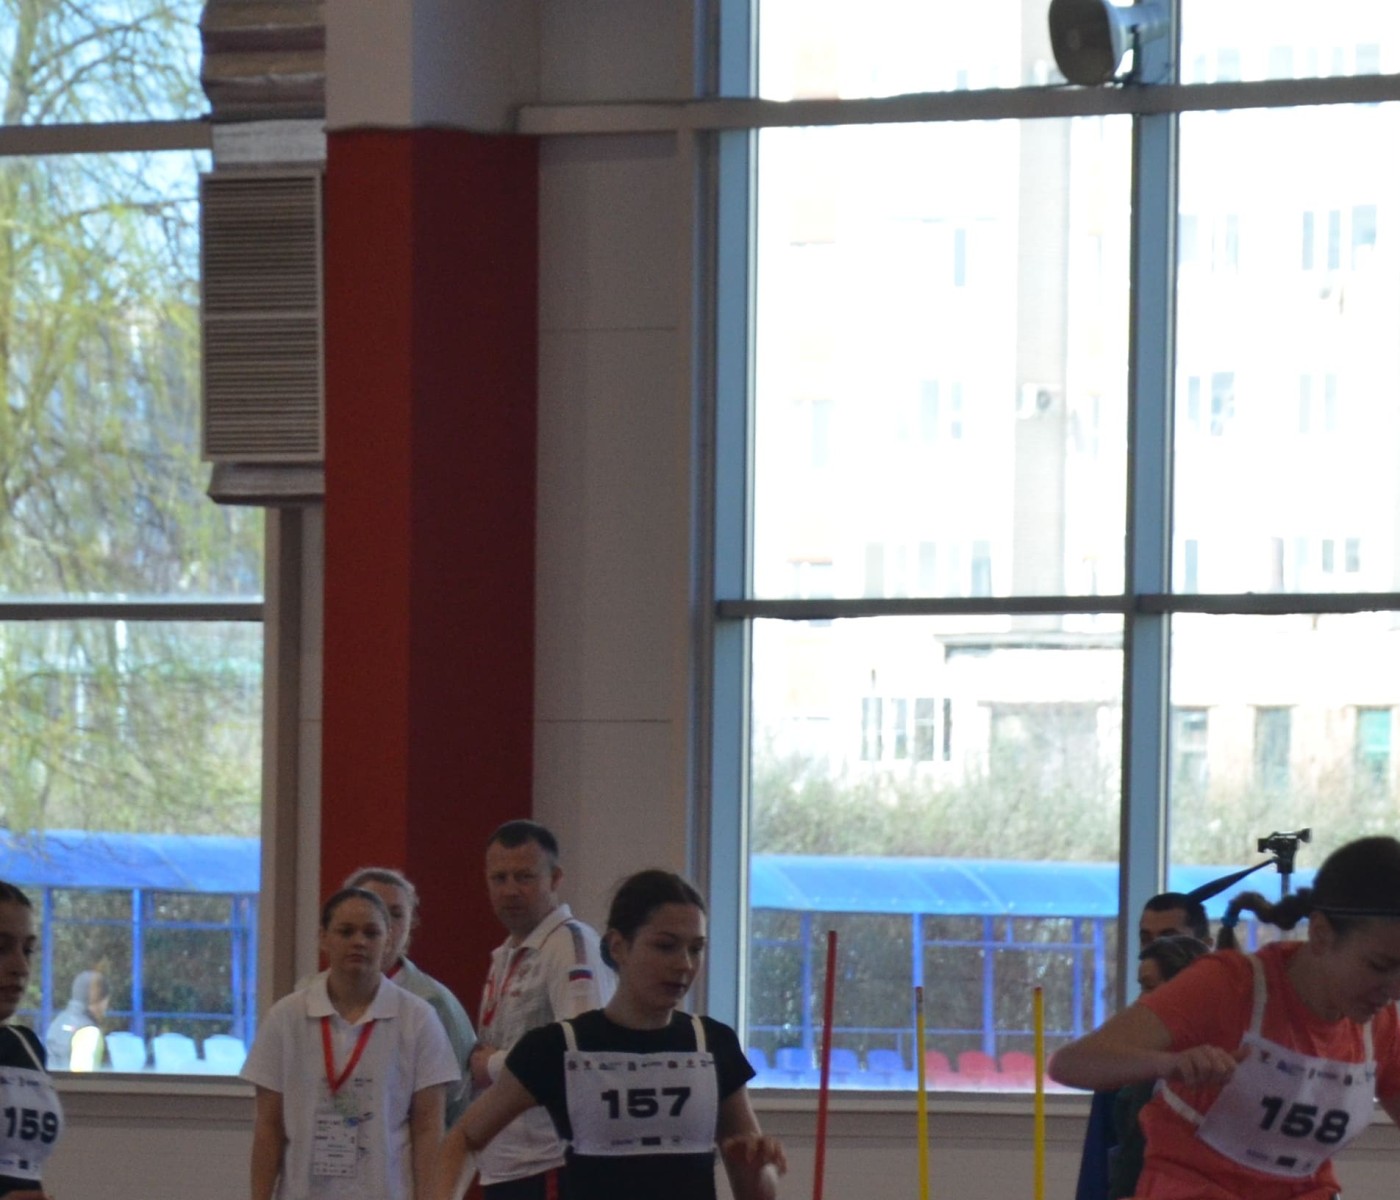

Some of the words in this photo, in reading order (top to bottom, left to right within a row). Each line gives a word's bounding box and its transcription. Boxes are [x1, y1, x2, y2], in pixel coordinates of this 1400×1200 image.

[601, 1087, 691, 1120] 157
[1259, 1096, 1350, 1144] 158
[4, 1106, 59, 1144] 159
